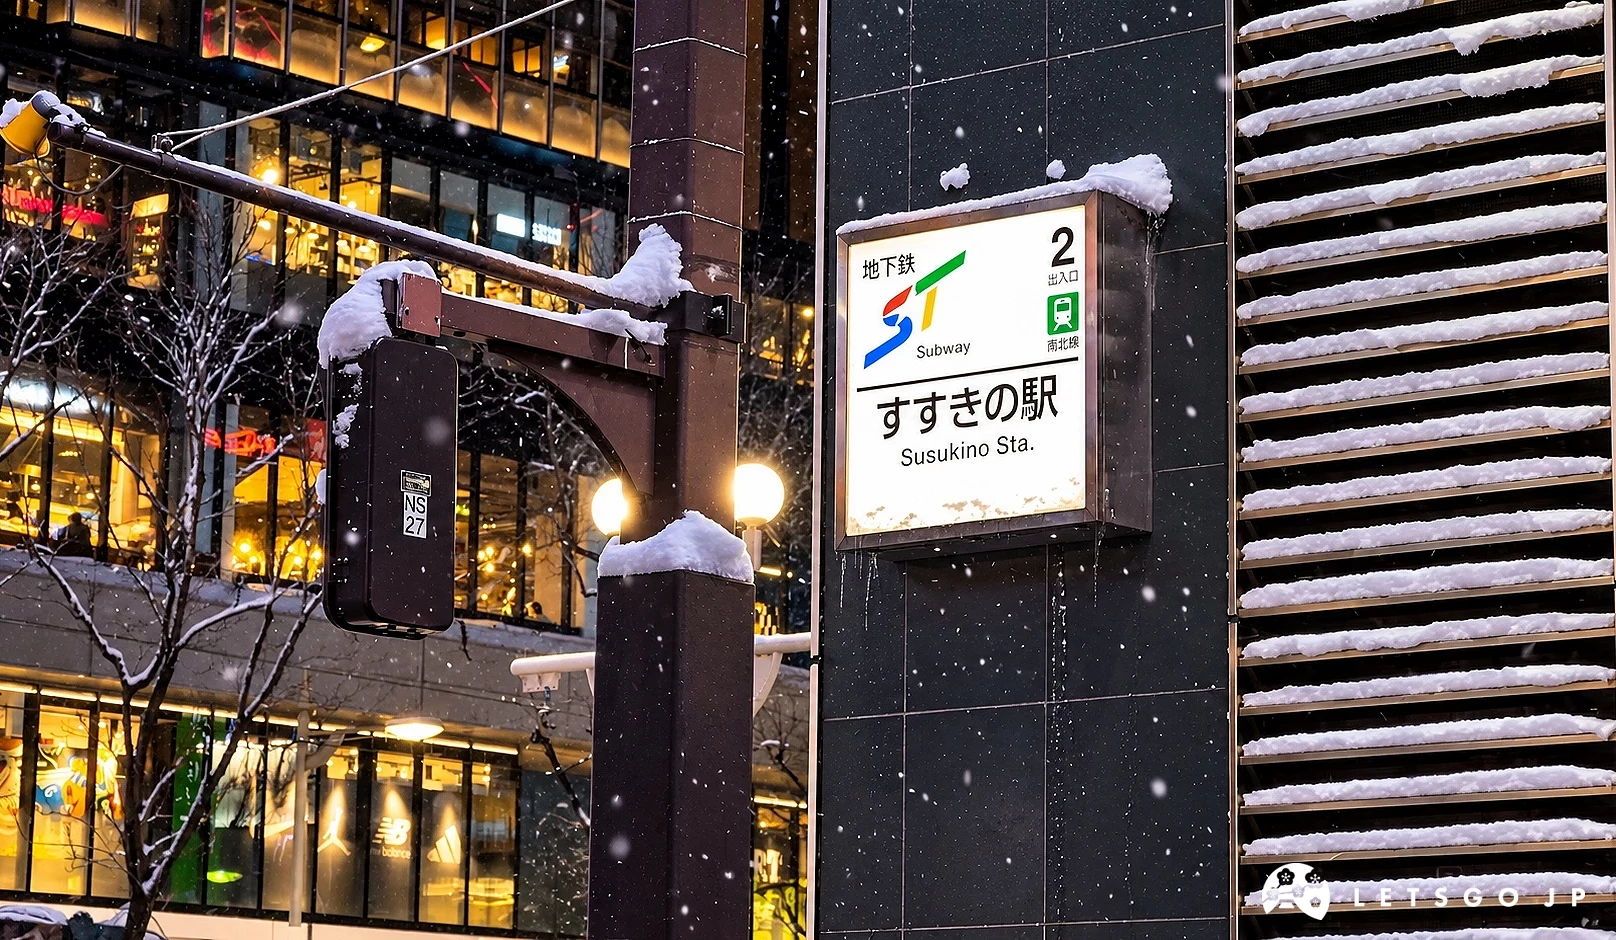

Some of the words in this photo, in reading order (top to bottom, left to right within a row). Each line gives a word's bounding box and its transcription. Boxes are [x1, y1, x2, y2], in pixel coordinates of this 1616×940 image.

[1051, 226, 1075, 268] 2
[862, 253, 916, 280] 地下鉄
[1048, 269, 1079, 287] 出入口
[916, 342, 971, 359] Subway
[876, 374, 1059, 440] すすきの駅
[900, 440, 990, 467] Susukino
[996, 435, 1035, 455] Sta.
[405, 494, 426, 515] NS
[405, 515, 425, 535] 27
